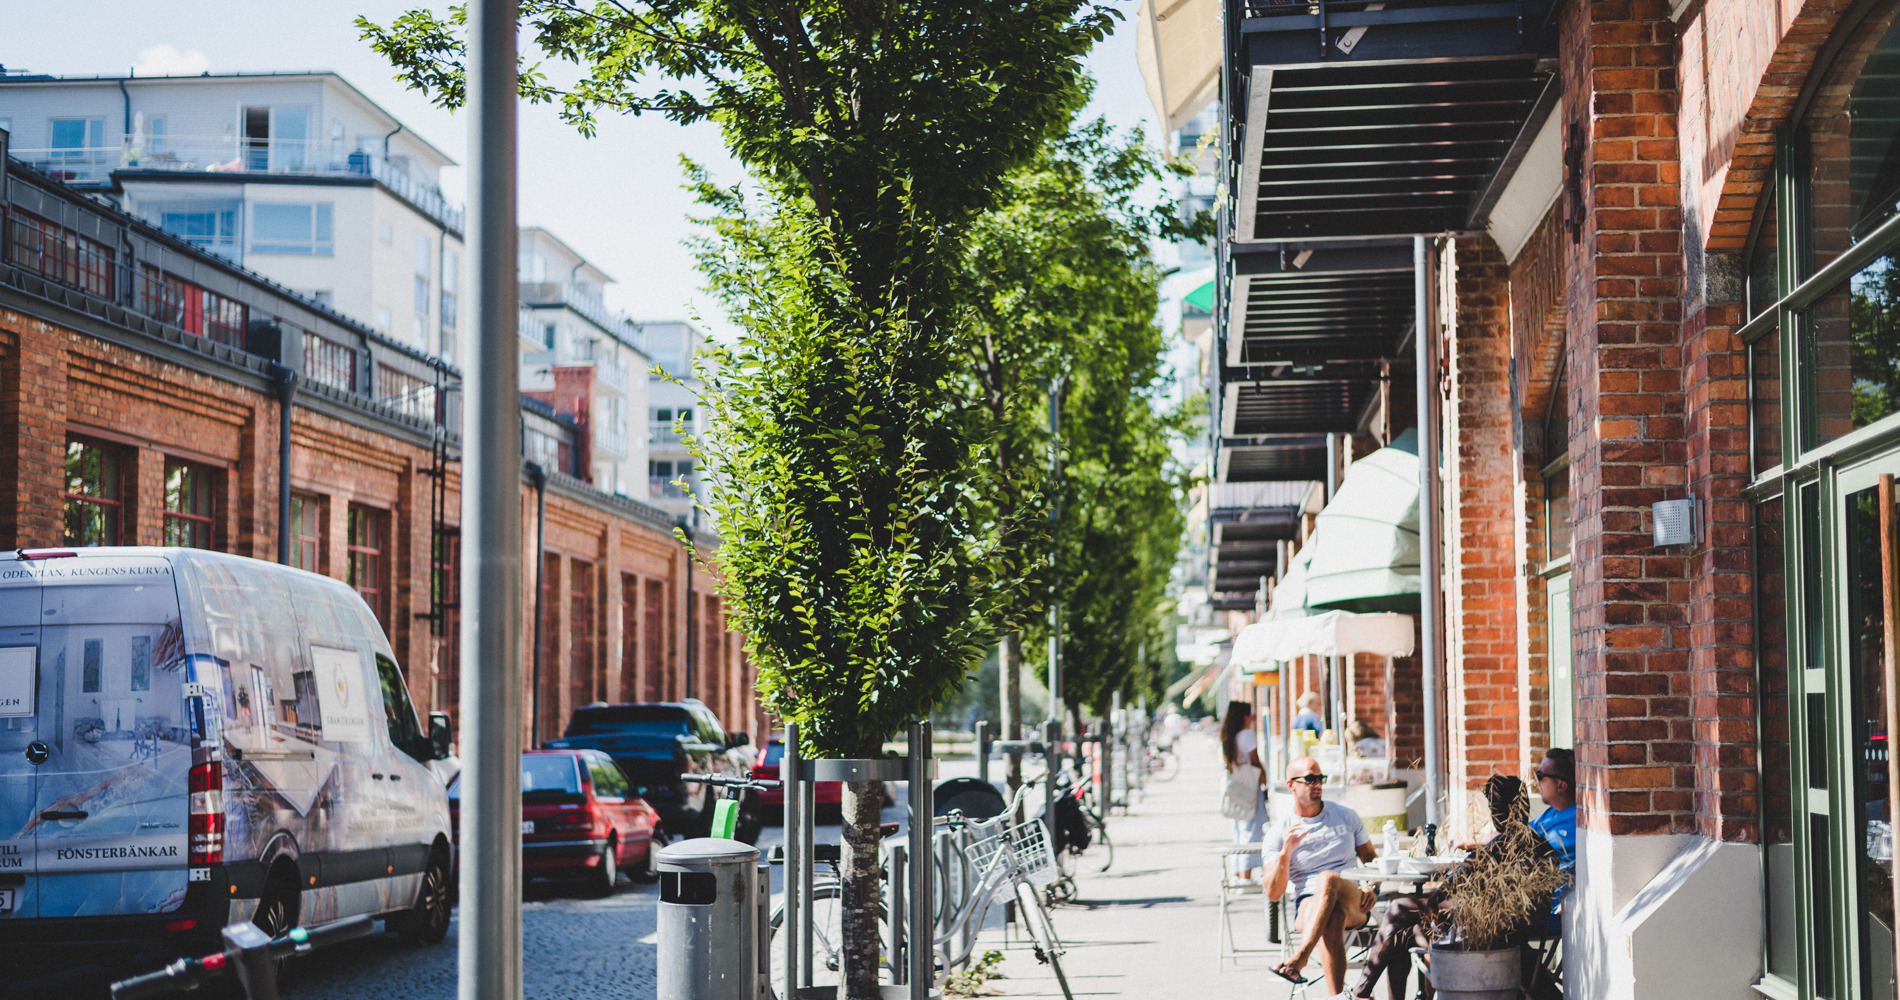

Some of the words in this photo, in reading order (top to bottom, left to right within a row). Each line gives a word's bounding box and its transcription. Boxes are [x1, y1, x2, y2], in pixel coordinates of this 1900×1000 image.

[2, 568, 66, 579] ODENPLAN,
[71, 566, 126, 577] KUNGENS
[129, 566, 170, 575] KURVA
[56, 844, 178, 860] FÖNSTERBÄNKAR
